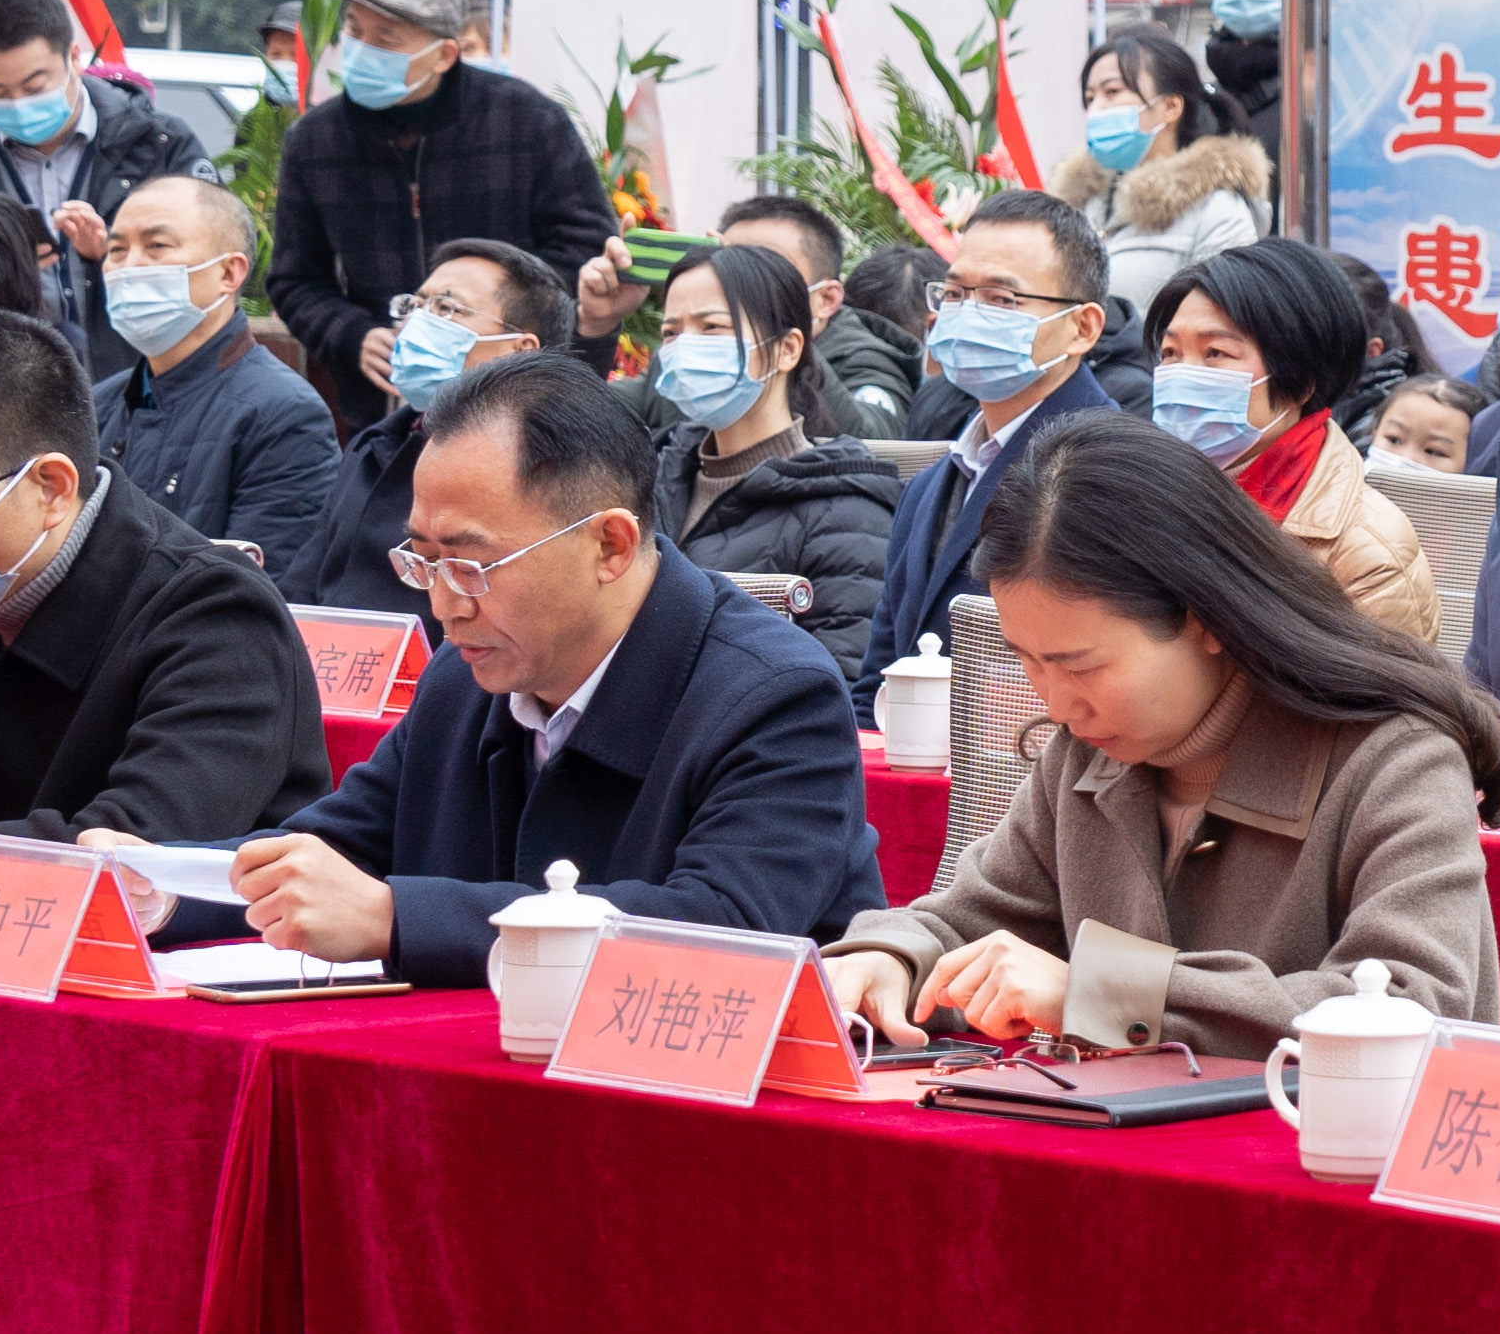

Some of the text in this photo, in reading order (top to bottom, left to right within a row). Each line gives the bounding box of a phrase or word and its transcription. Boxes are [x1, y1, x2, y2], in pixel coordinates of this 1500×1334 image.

[307, 643, 385, 697] 宾席
[594, 972, 758, 1060] 刘艳萍
